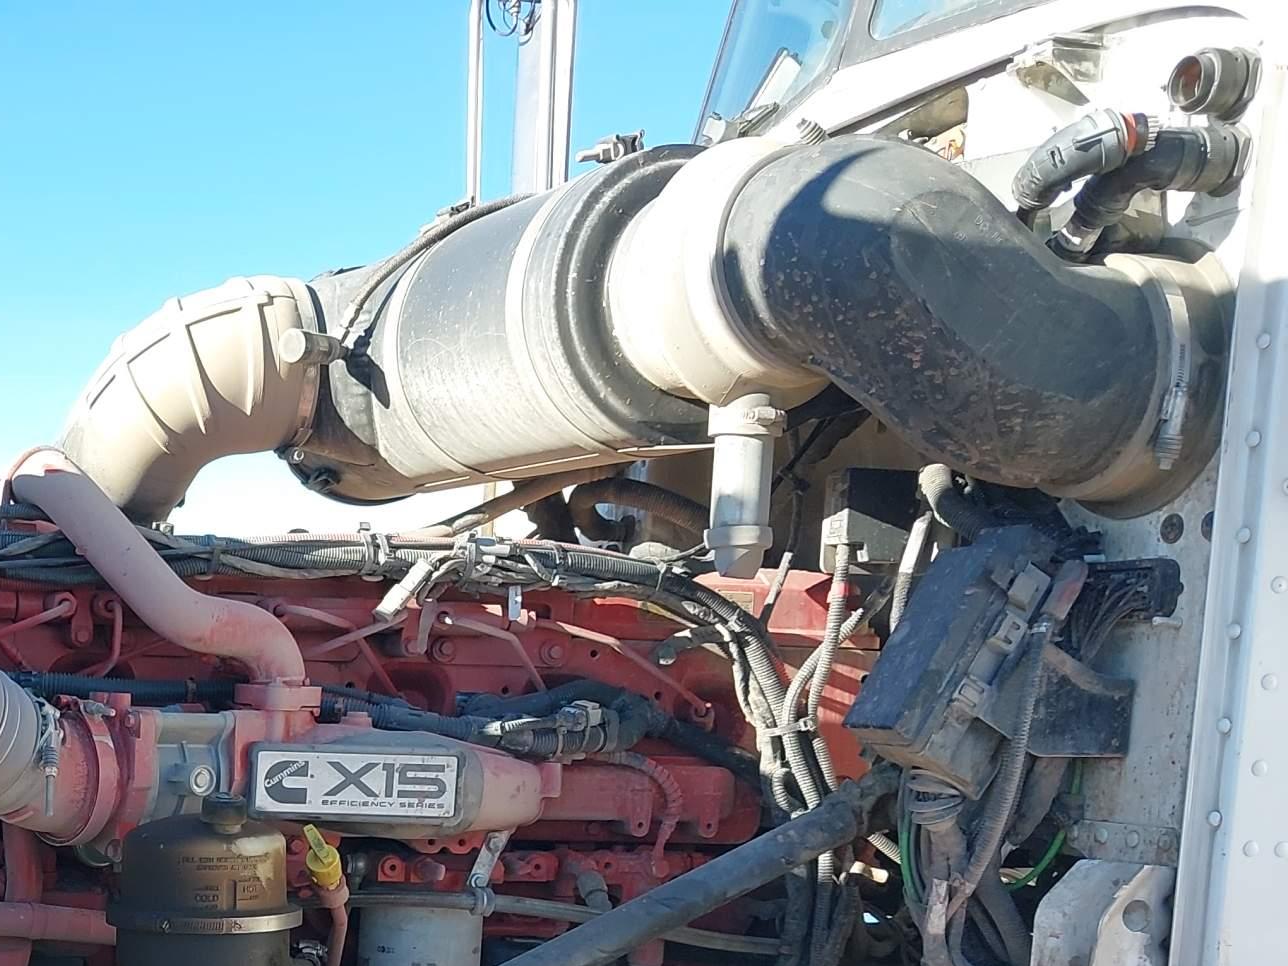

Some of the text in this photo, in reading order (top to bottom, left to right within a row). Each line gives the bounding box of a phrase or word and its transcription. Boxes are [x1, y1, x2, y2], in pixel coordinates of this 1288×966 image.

[264, 760, 306, 788] Cummins
[322, 761, 447, 799] X15
[321, 799, 445, 810] EFFICIENCY SERIES
